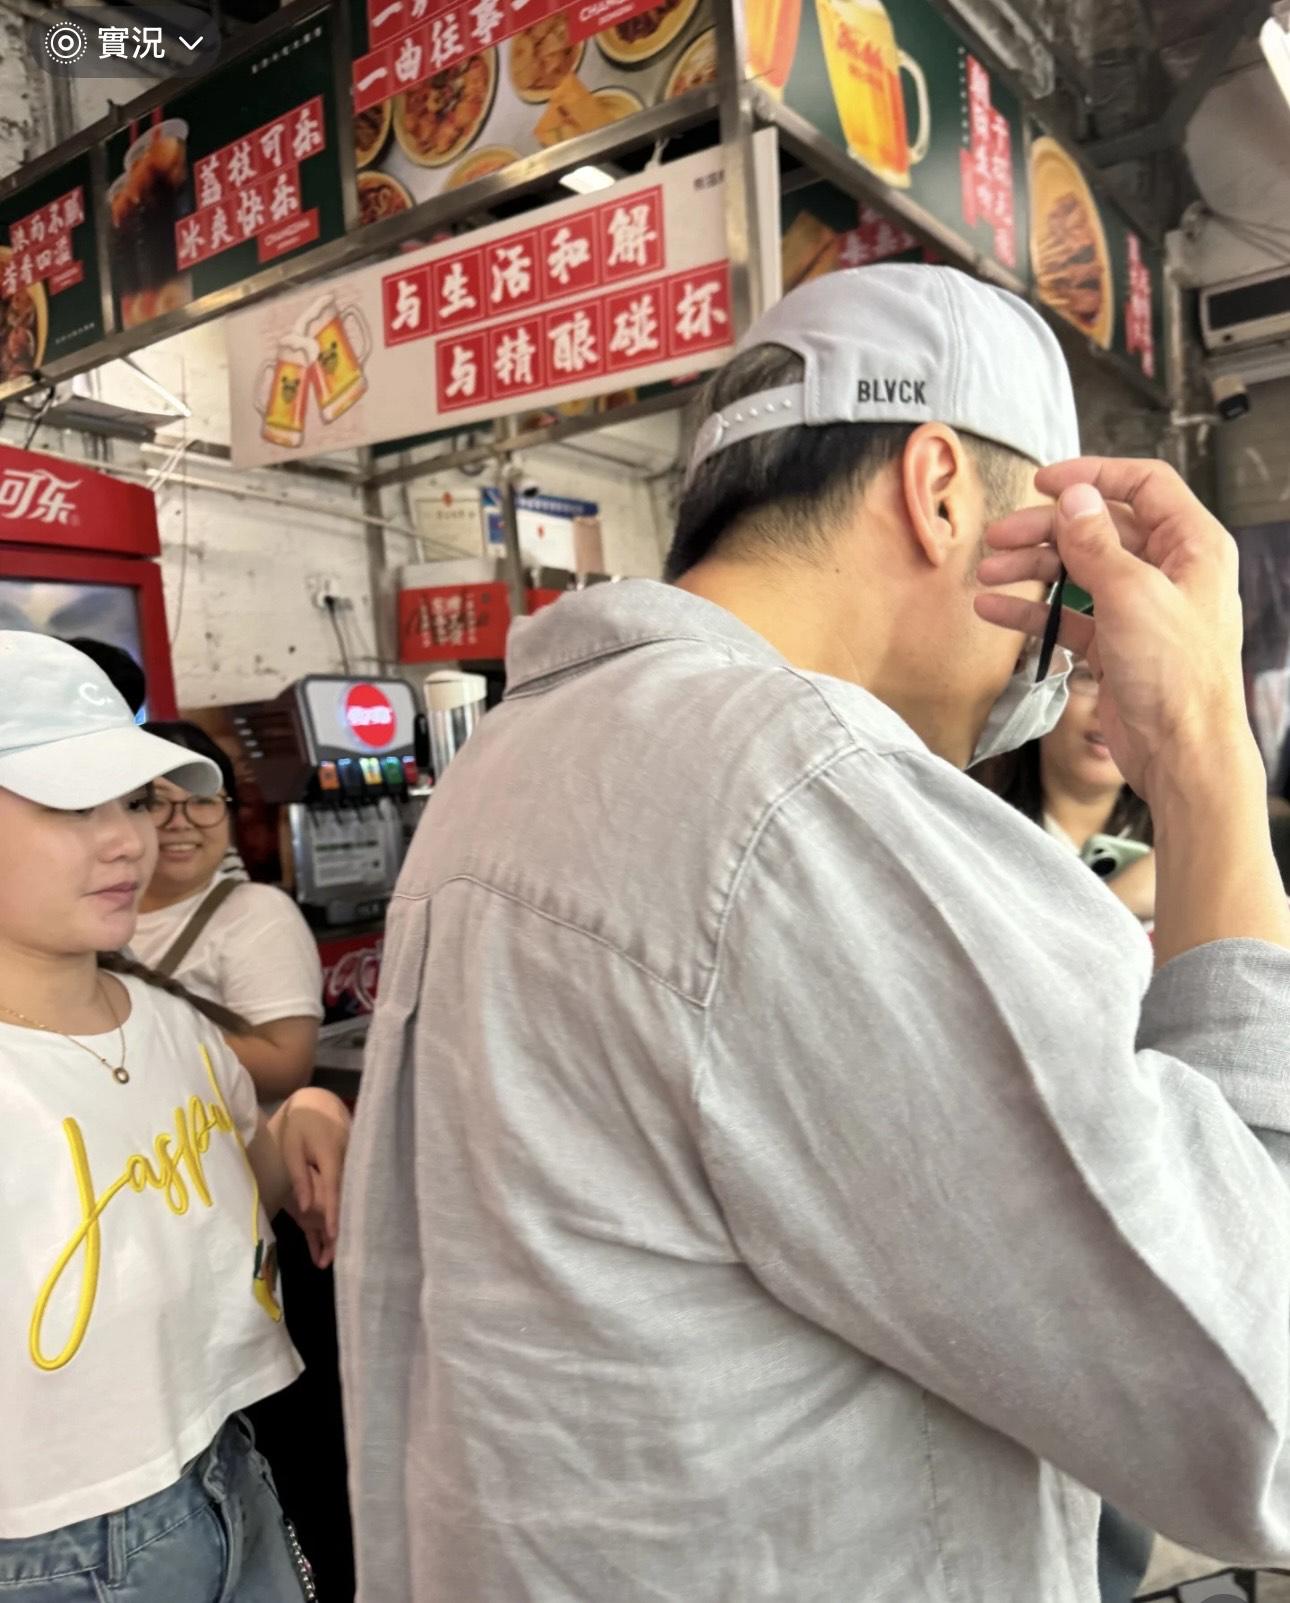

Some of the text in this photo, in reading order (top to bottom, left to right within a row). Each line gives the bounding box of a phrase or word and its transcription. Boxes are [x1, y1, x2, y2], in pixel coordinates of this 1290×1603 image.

[200, 107, 322, 206] 荔枝可乐
[391, 204, 657, 331] 与生活和解
[445, 280, 727, 398] 与精酿碰杯
[857, 379, 926, 405] BLVCK
[0, 468, 83, 525] 可乐
